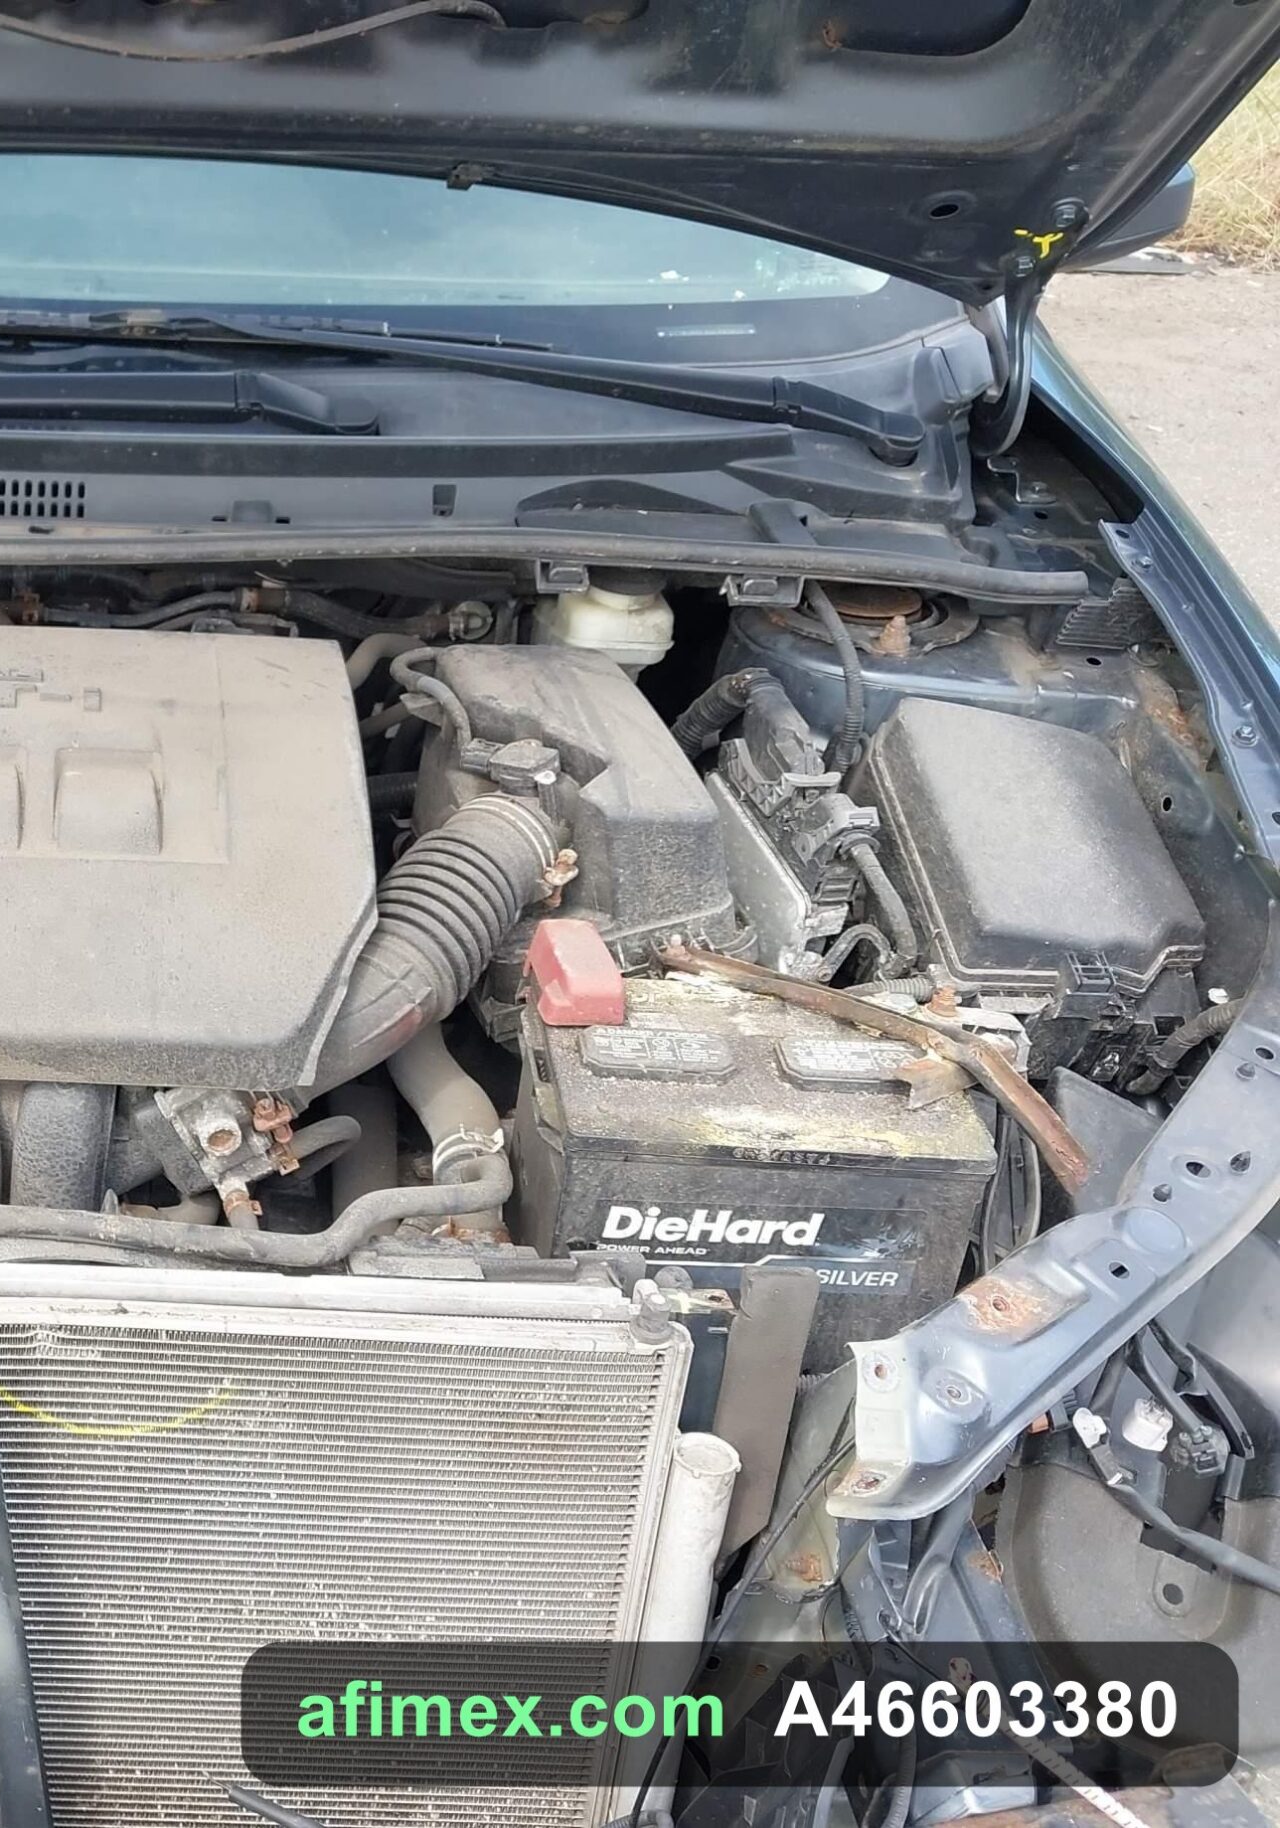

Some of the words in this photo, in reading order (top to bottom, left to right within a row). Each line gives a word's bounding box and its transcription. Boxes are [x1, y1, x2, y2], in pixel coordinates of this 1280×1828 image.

[601, 1205, 826, 1246] DieHard
[596, 1243, 651, 1253] POWER
[654, 1247, 708, 1255] AHEAD
[816, 1268, 899, 1287] SILVER
